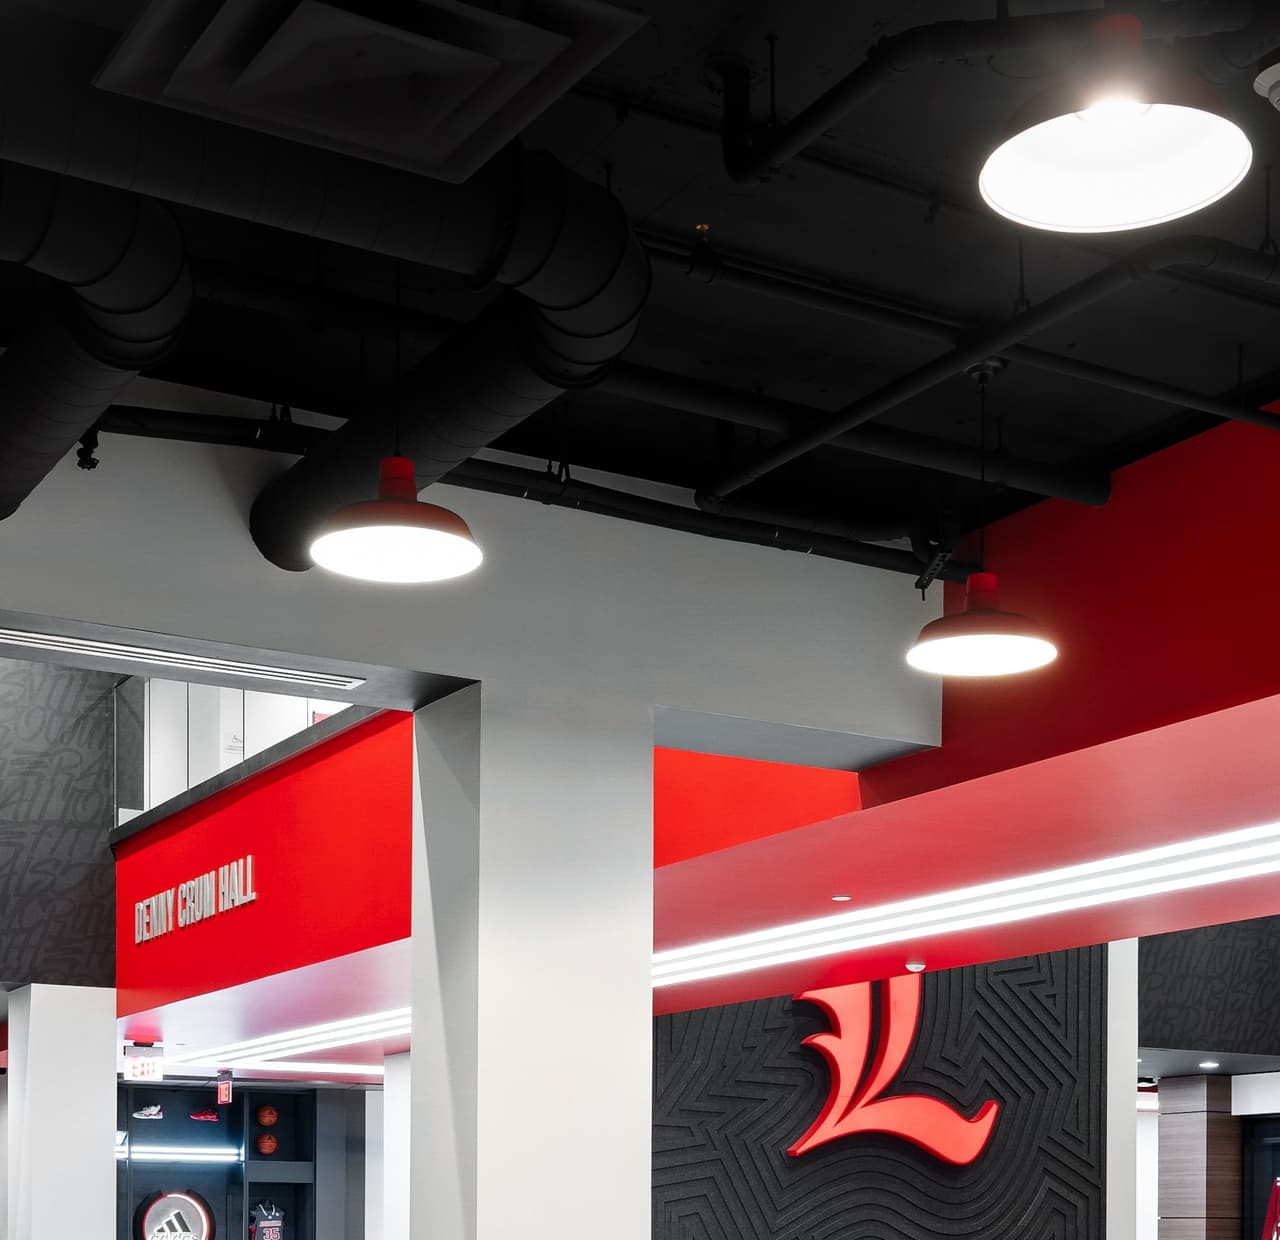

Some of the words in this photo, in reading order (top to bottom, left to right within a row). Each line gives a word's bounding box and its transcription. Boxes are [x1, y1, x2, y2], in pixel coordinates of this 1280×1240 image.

[135, 888, 176, 944] DENNY
[178, 870, 216, 928] CRUM
[218, 855, 257, 912] HALL
